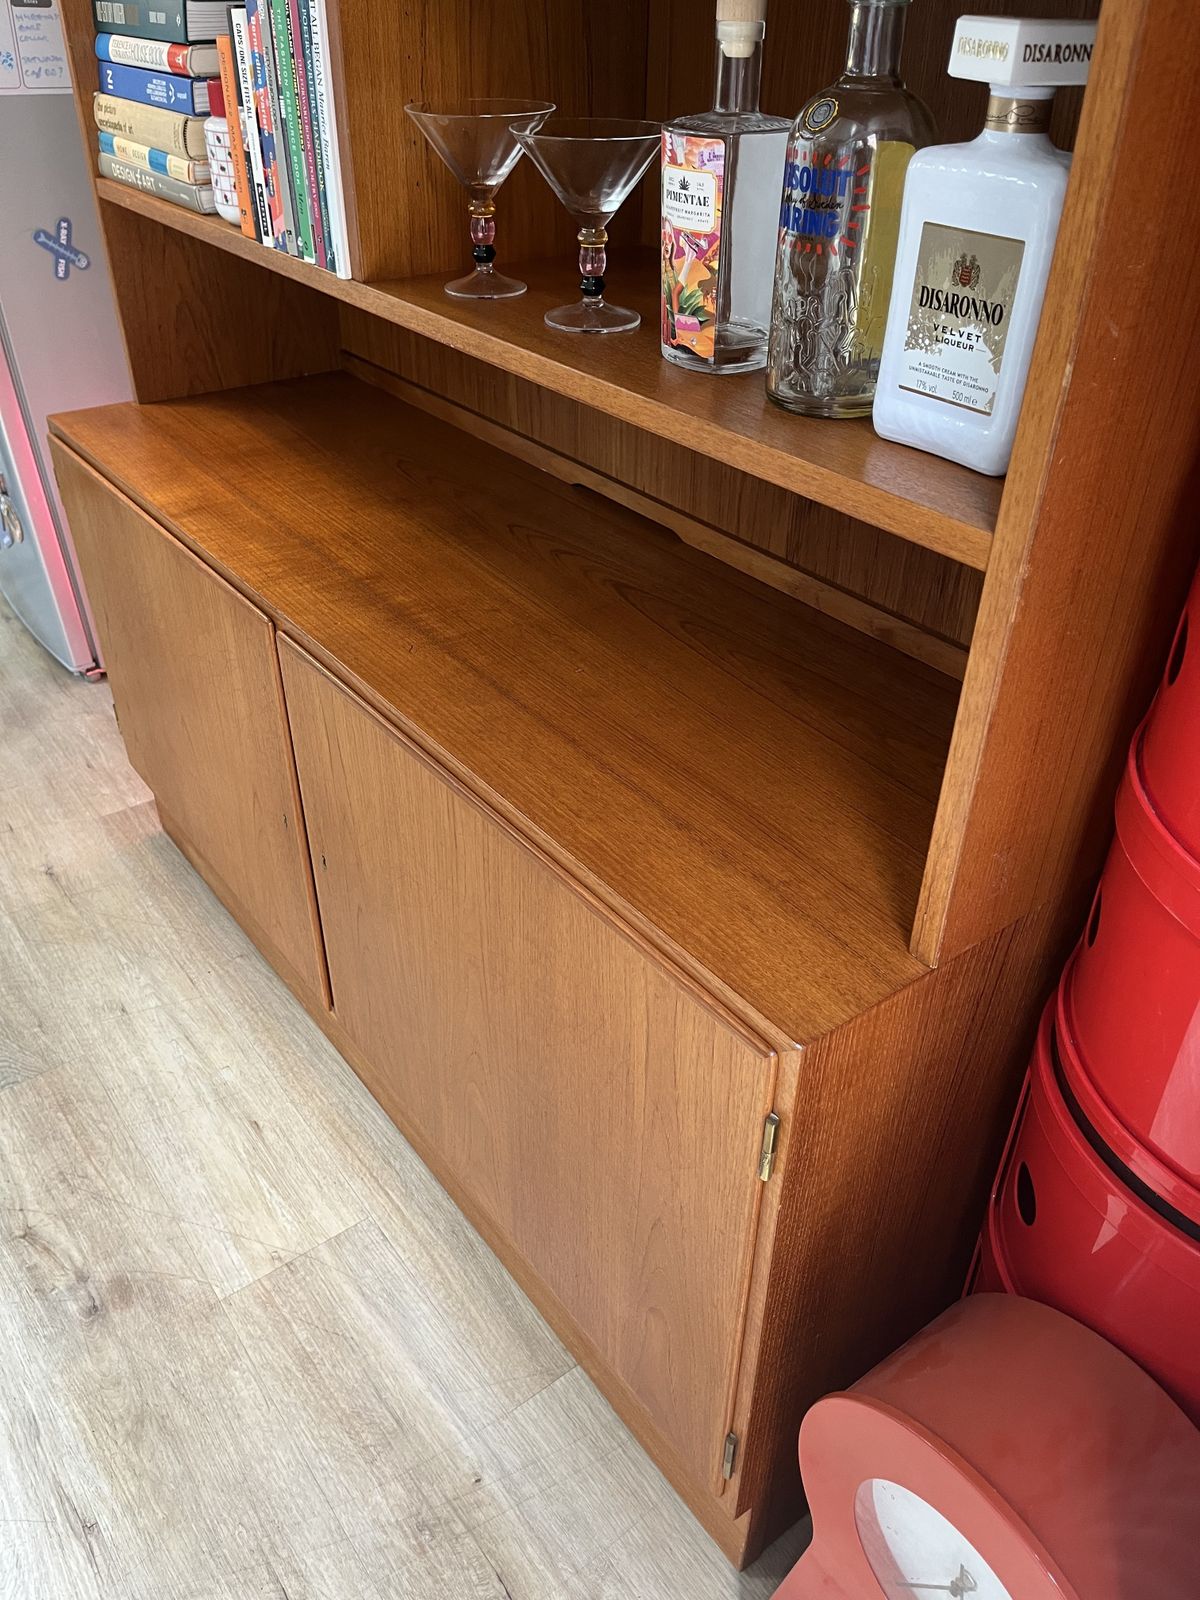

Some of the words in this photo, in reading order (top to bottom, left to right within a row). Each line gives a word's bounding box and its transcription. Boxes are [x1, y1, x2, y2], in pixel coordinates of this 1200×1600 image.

[276, 8, 284, 30] THE
[250, 16, 263, 86] Bernardine
[279, 35, 290, 86] FASHION
[1022, 43, 1094, 65] DISARONN
[220, 51, 230, 92] DESIGN
[240, 66, 249, 84] SIZE
[314, 42, 324, 87] BEGAN
[243, 86, 251, 104] FITS
[302, 8, 312, 56] POETRY
[312, 121, 326, 192] HANDBOOK
[246, 105, 254, 120] ALL
[256, 87, 270, 137] Evaristo
[285, 91, 297, 151] RESOURCE
[111, 162, 136, 184] DESIGN
[293, 156, 301, 185] BOOK
[666, 188, 710, 208] PIMENTAE
[919, 285, 1005, 327] DISARONNO
[933, 323, 983, 344] VELVET
[935, 335, 975, 353] LIQUEUR
[941, 367, 957, 376] CREAM
[916, 379, 927, 391] 17%
[952, 390, 964, 402] 500
[962, 381, 989, 394] DISARONNO
